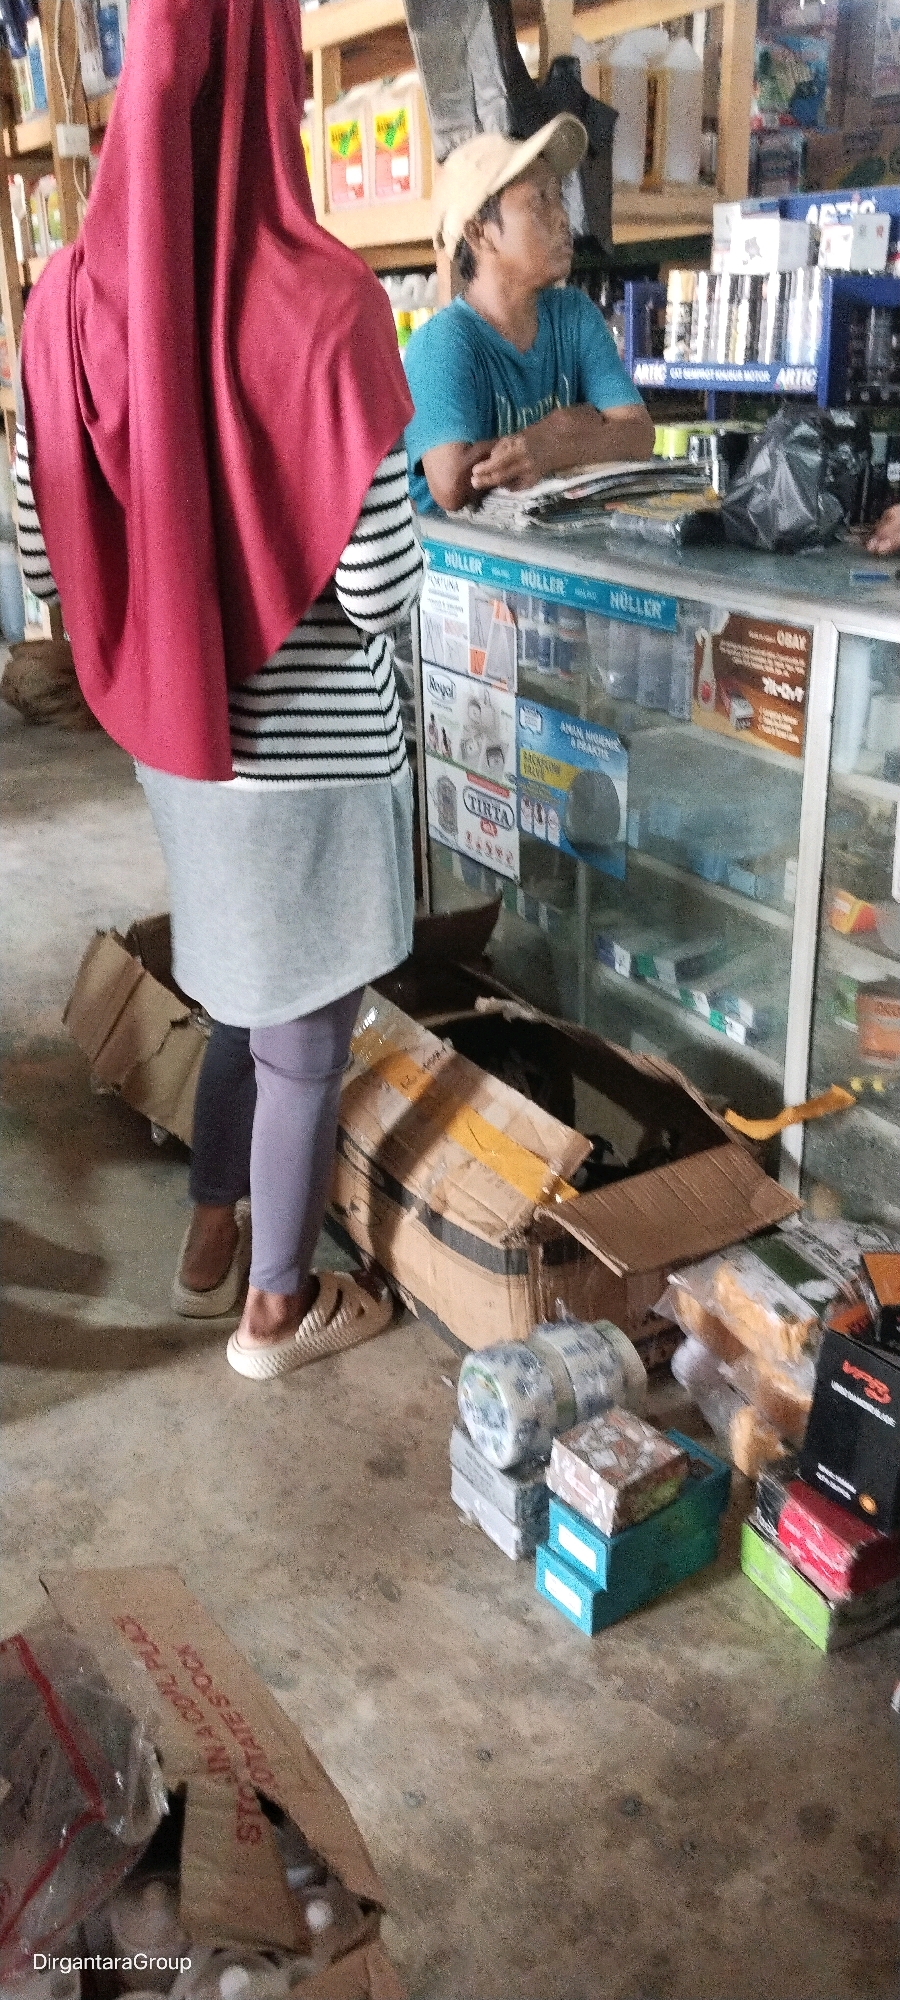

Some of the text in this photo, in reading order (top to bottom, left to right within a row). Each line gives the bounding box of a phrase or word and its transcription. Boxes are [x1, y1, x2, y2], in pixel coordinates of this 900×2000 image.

[634, 363, 667, 383] ARTIC
[777, 367, 817, 388] ARTIC
[467, 793, 511, 832] TIRTA
